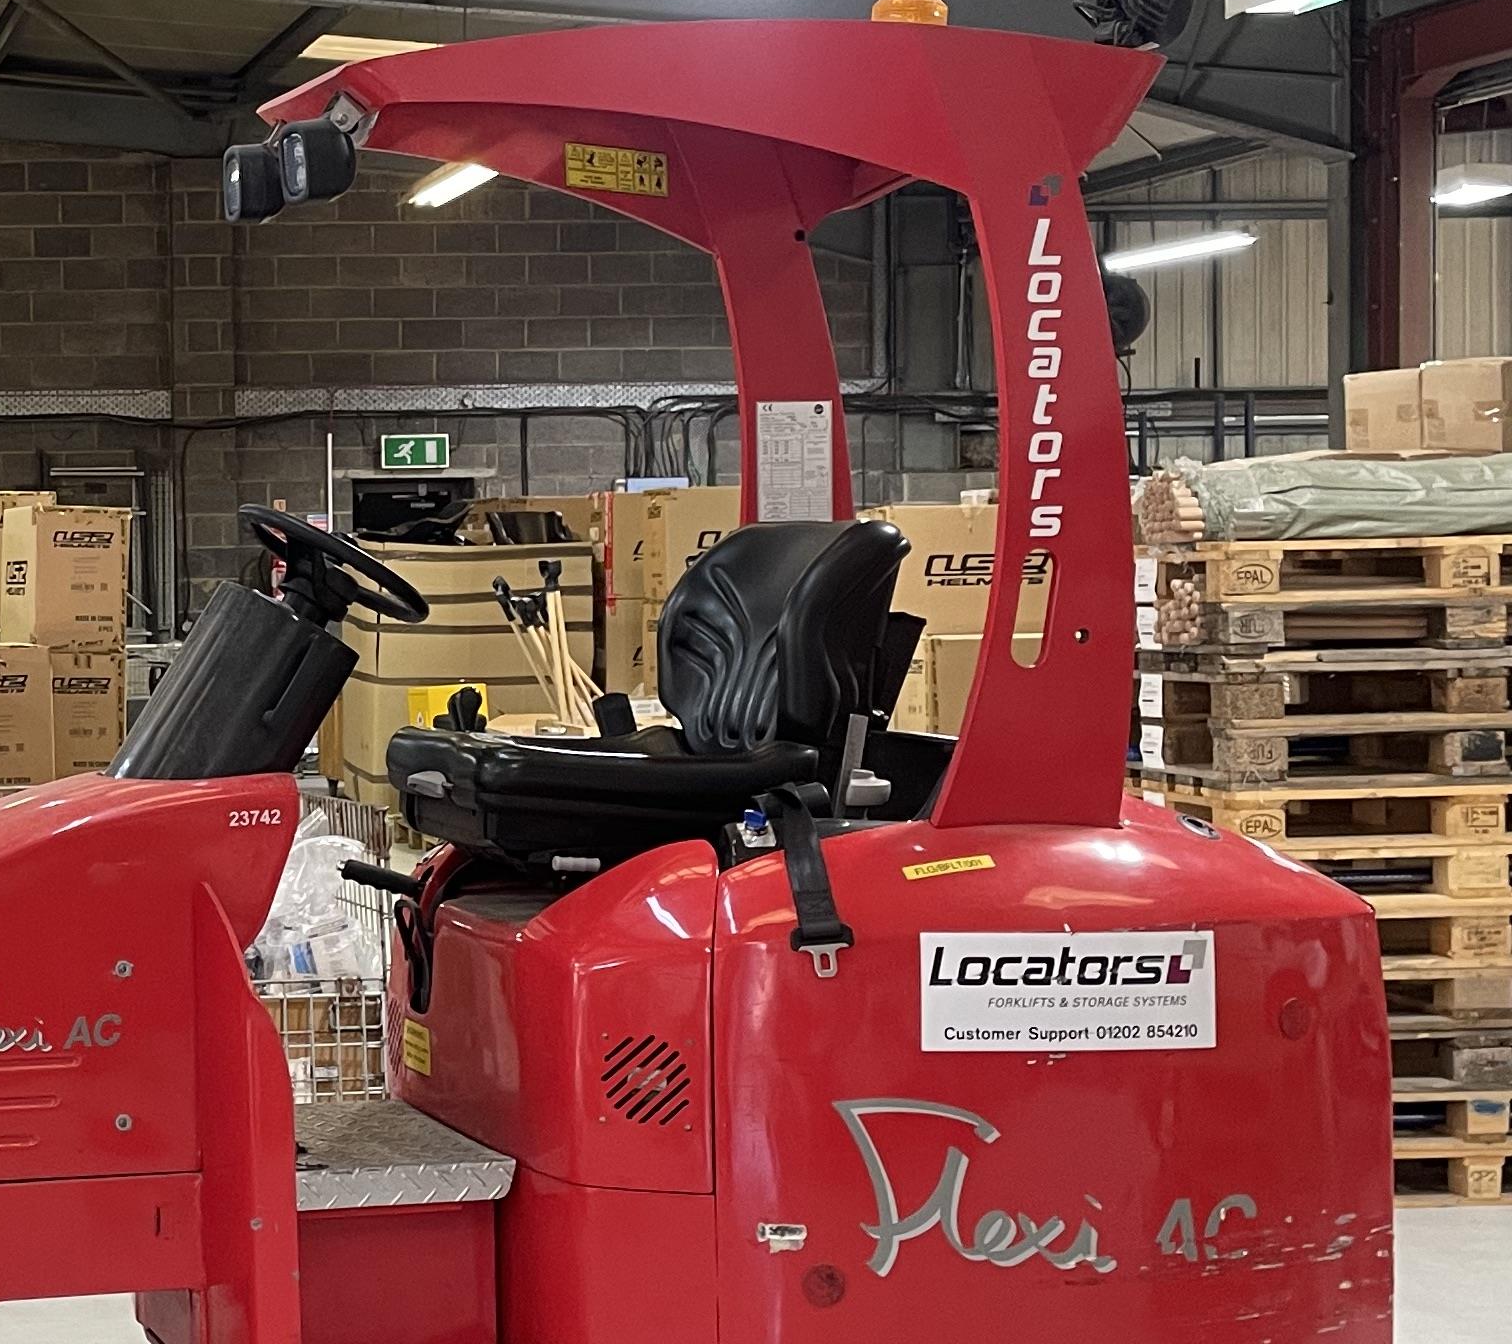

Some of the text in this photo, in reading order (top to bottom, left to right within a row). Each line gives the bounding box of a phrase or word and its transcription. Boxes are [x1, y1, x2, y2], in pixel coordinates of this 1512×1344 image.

[1027, 218, 1063, 537] Locators
[927, 576, 1044, 587] HELMS
[228, 809, 282, 827] 23742
[1245, 820, 1277, 834] EPAL
[929, 946, 1165, 986] Locators
[988, 995, 1188, 1008] FORKLIFTS & STORAGE SYSTEMS
[63, 1013, 123, 1050] AC
[944, 1024, 1198, 1043] Customer Support 01202 854210
[831, 1097, 1258, 1278] Flexi AC
